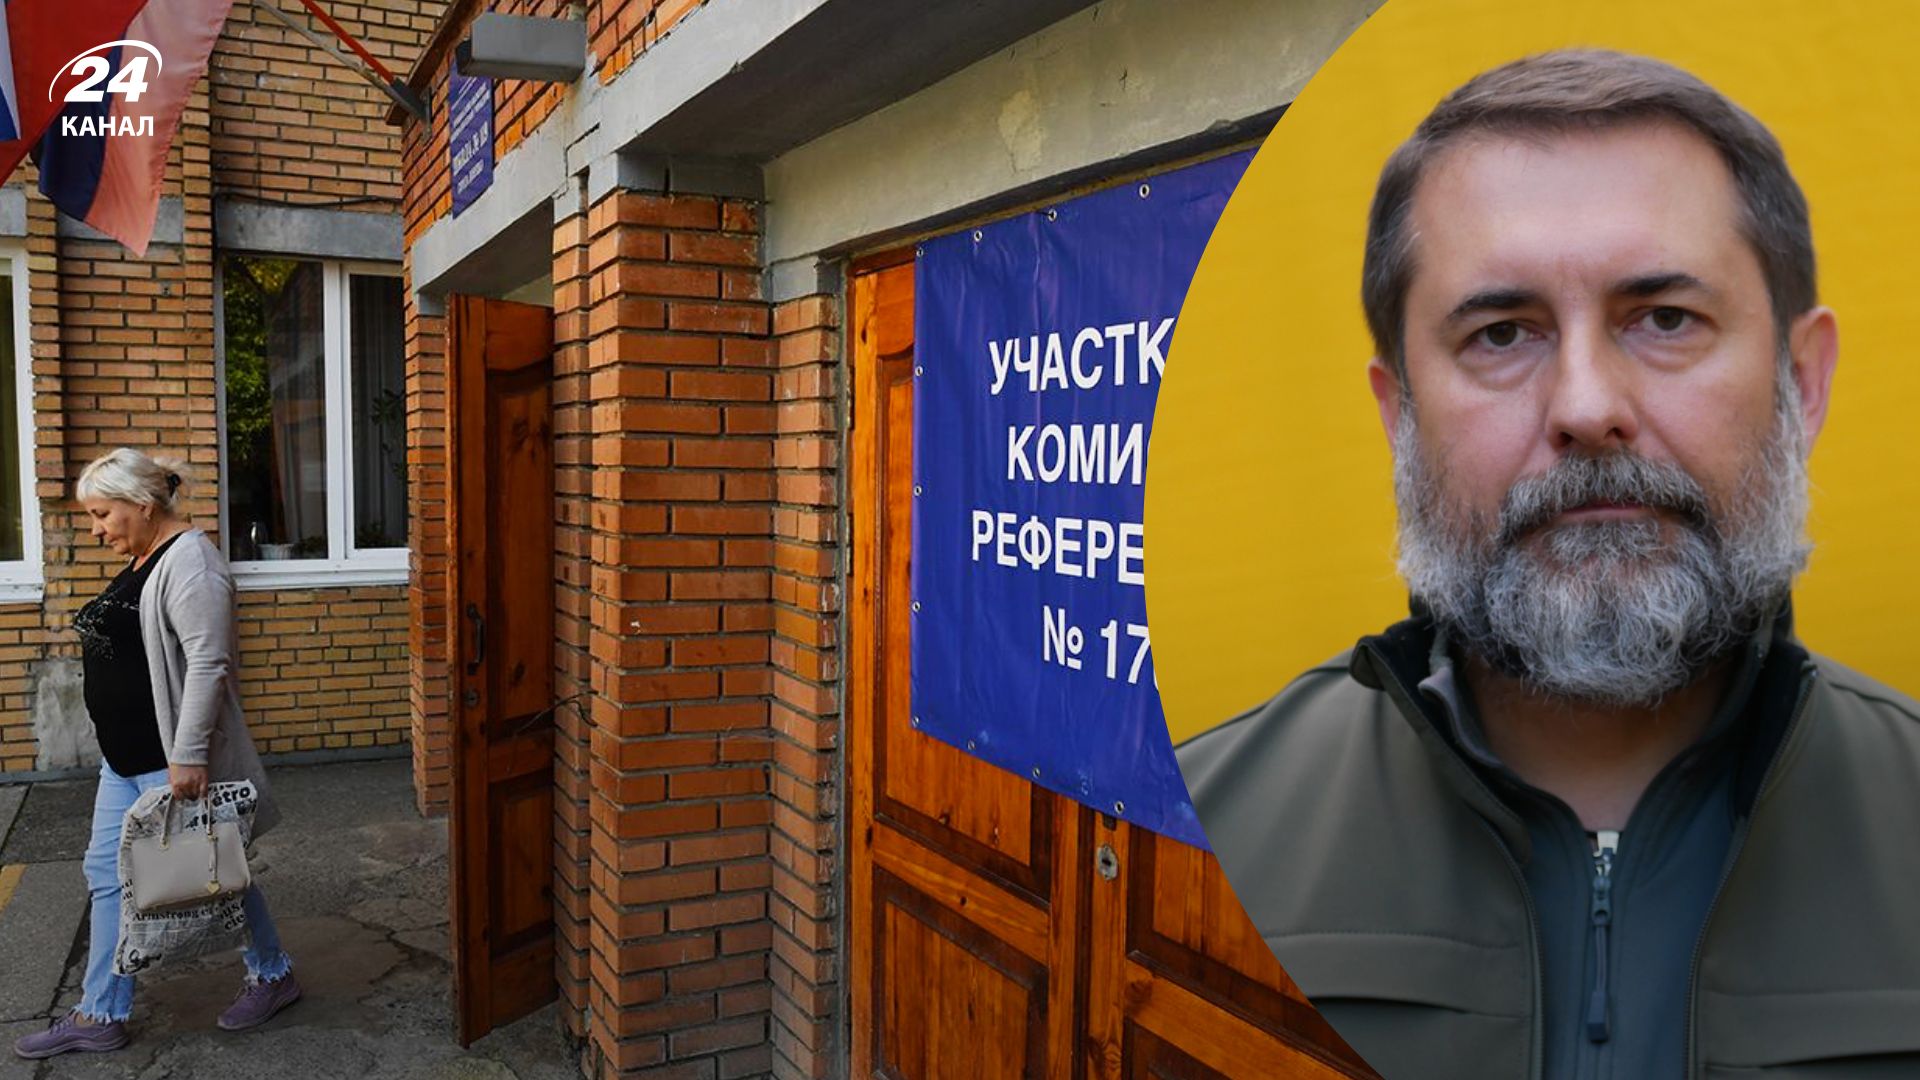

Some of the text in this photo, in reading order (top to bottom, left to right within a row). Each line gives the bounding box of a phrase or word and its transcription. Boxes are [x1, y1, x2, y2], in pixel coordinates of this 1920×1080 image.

[988, 317, 1175, 396] УЧАСТК
[1007, 423, 1150, 485] КОМИ
[972, 509, 1145, 586] РЕФЕРЕ
[1043, 604, 1158, 690] № 17
[204, 786, 250, 810] étro
